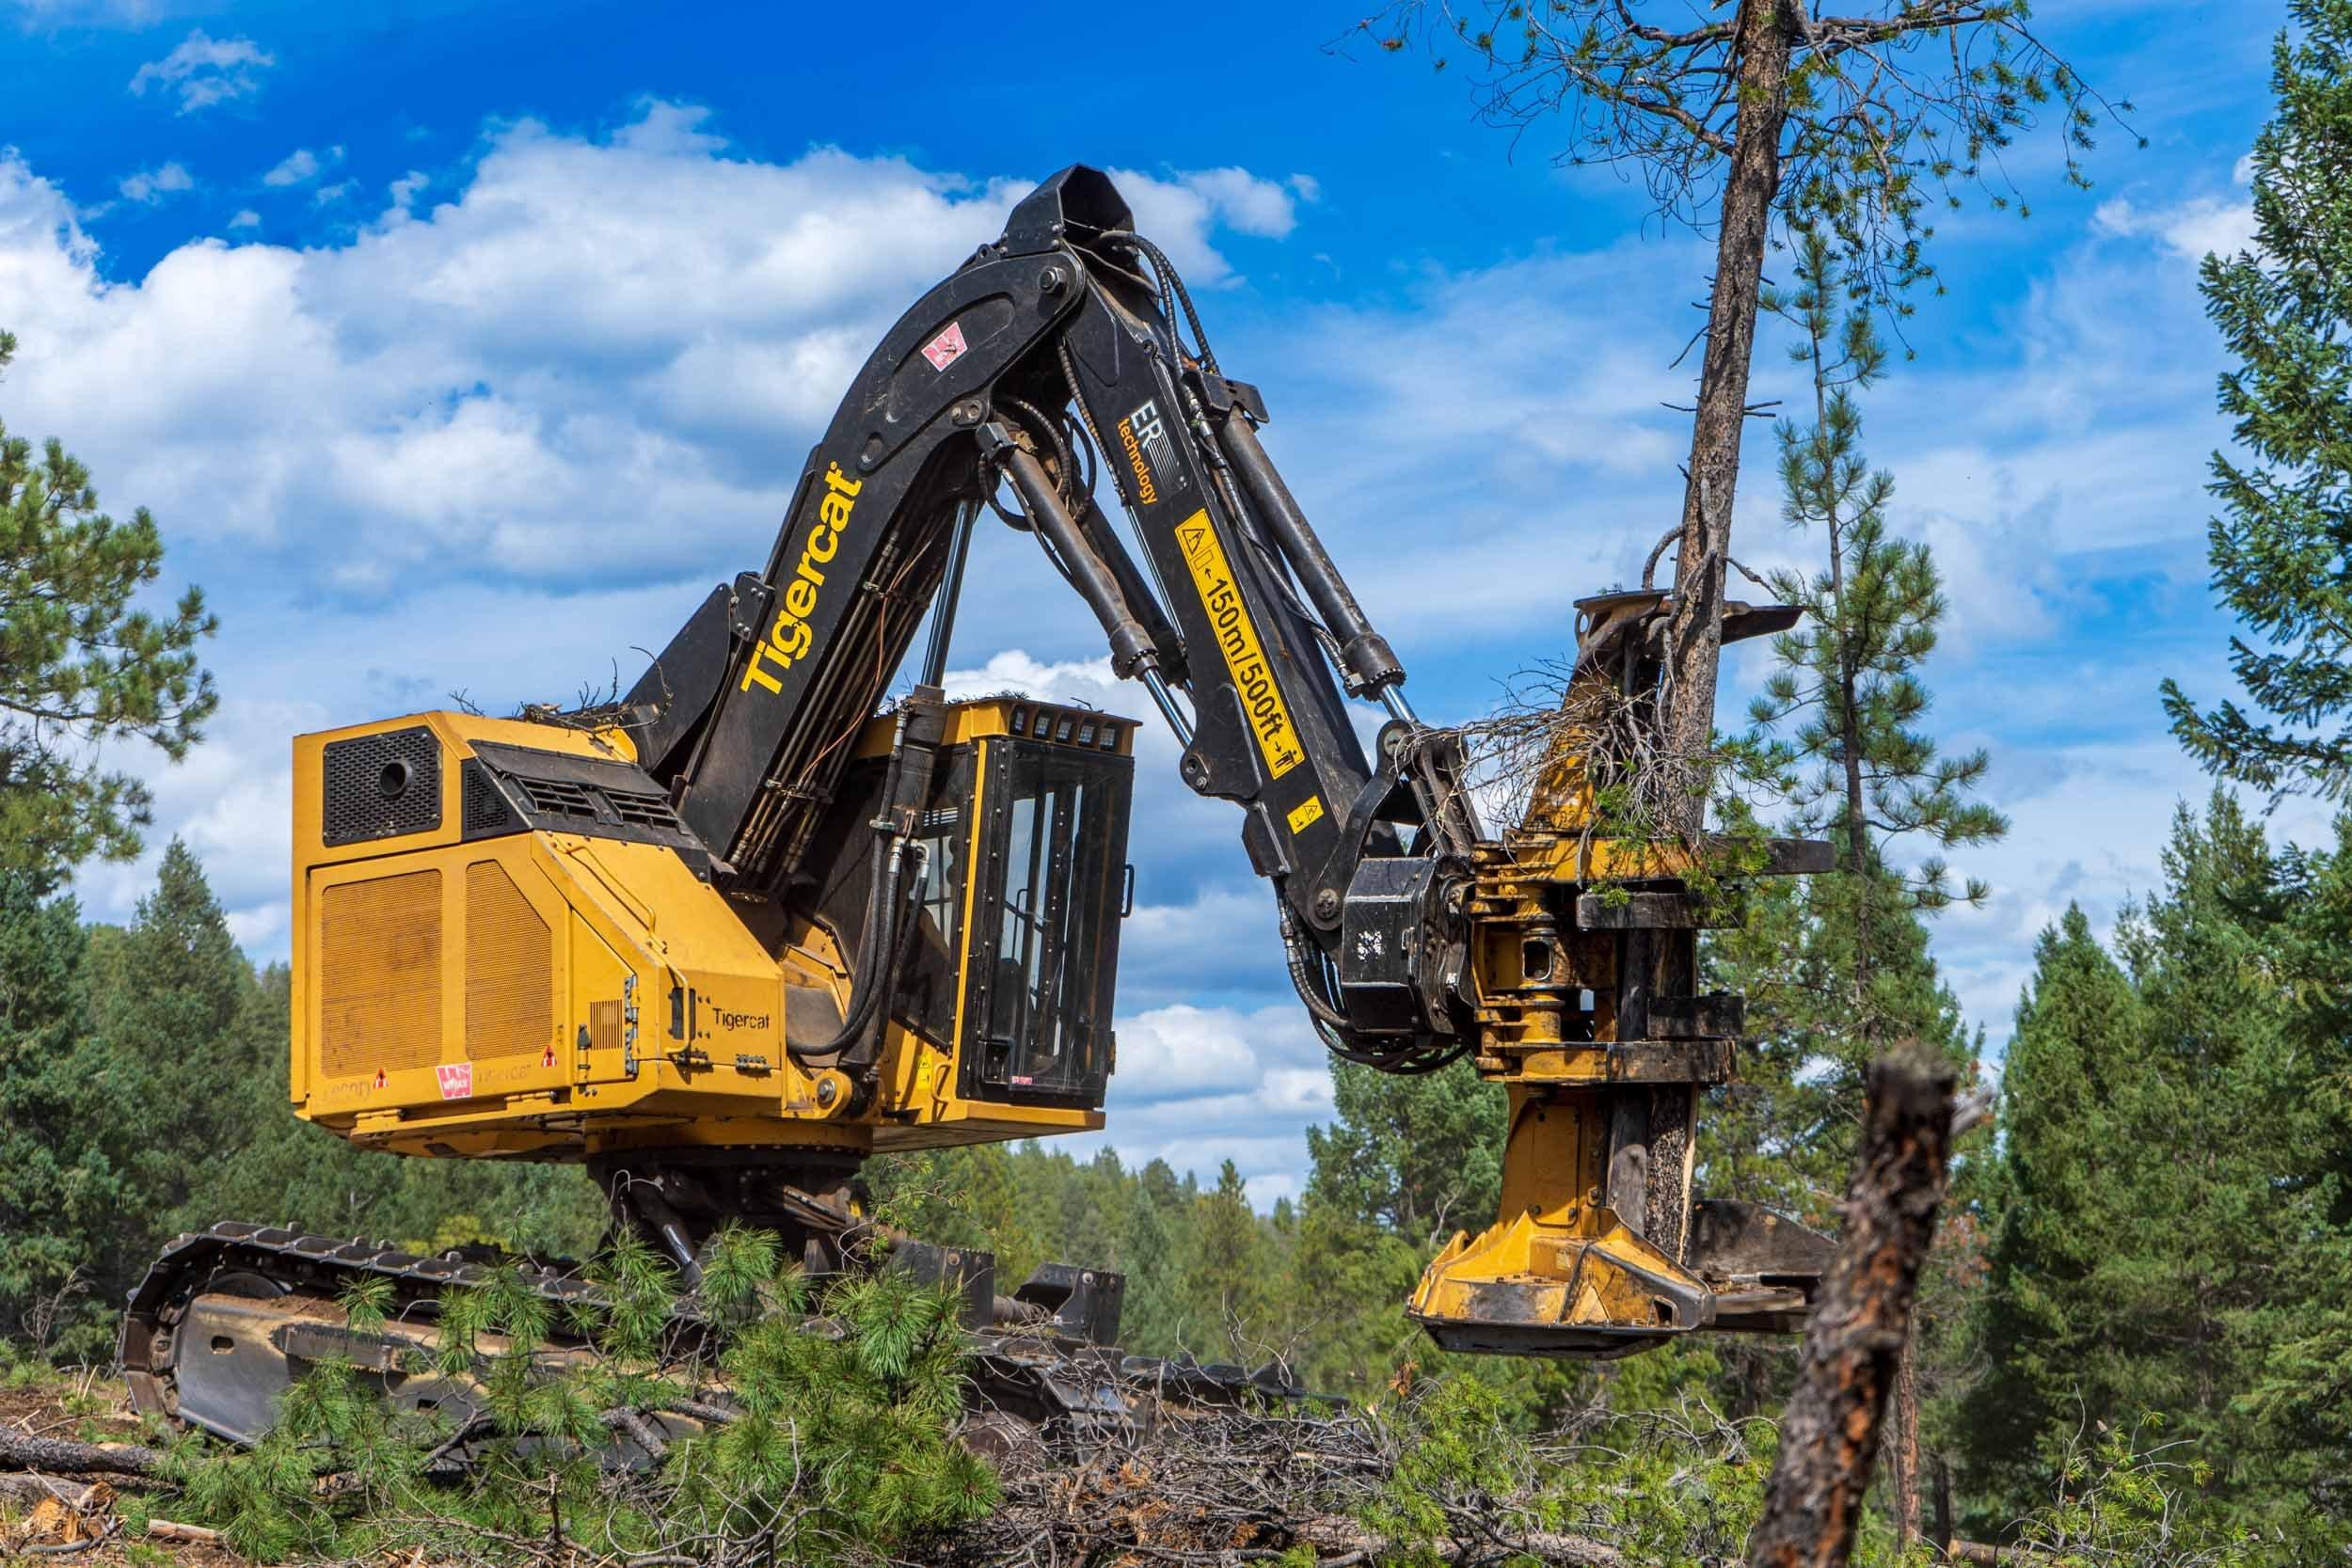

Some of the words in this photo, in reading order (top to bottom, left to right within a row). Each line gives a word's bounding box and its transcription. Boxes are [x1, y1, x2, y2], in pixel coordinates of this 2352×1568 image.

[1130, 400, 1164, 449] ER
[1117, 417, 1158, 505] technology
[740, 461, 863, 695] Tigercat
[712, 1007, 770, 1031] Tigercat
